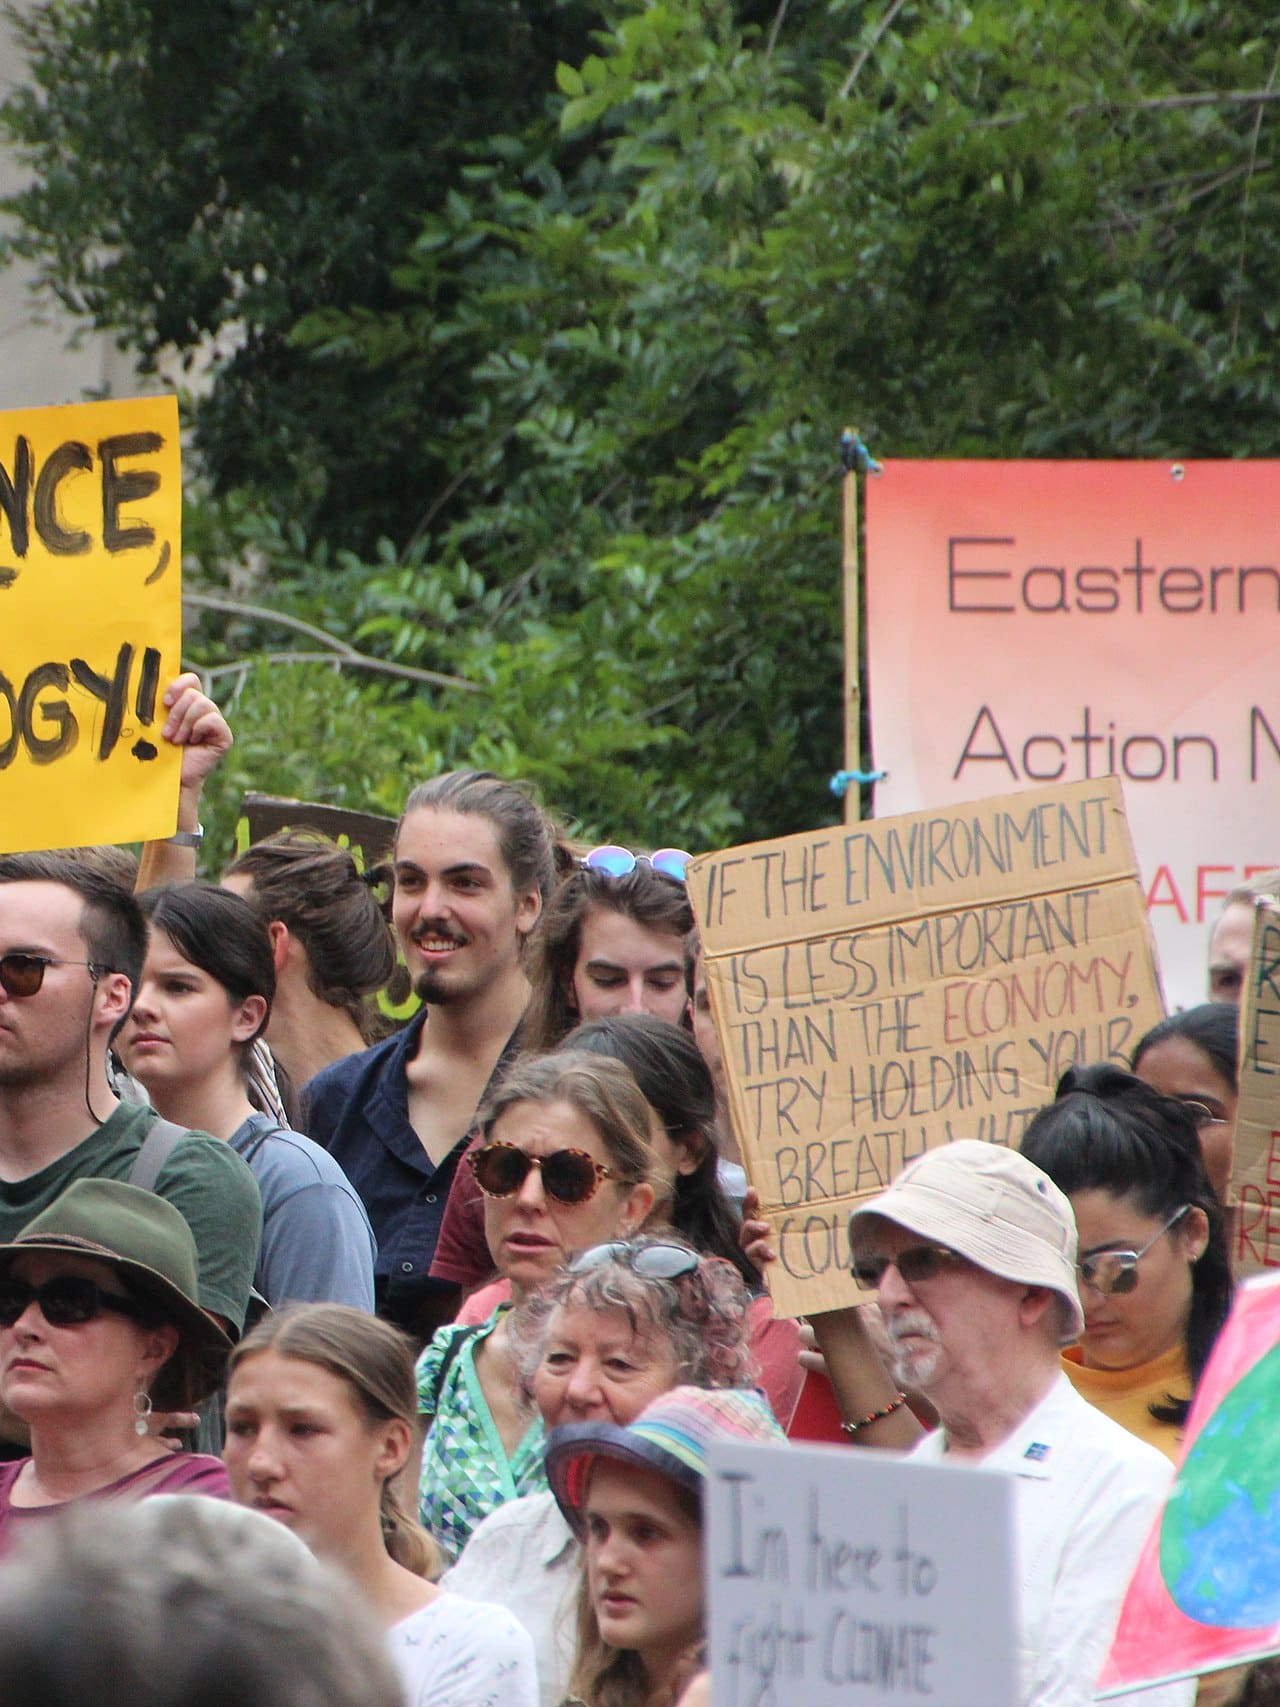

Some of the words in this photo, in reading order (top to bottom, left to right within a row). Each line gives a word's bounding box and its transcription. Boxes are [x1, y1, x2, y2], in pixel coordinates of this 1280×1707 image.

[949, 537, 1280, 614] Eastern
[953, 704, 1219, 783] Action
[751, 841, 830, 919] THE
[844, 797, 1111, 905] ENVIRONMENT
[731, 949, 768, 1015] IS
[783, 932, 878, 1009] LESS
[888, 889, 1100, 988] IMPORTANT
[730, 1008, 838, 1077] THAN
[850, 991, 932, 1056] THE
[745, 1071, 826, 1140] TRY
[850, 1041, 1019, 1127] HOLDING
[806, 1485, 882, 1594] here
[893, 1500, 939, 1598] to
